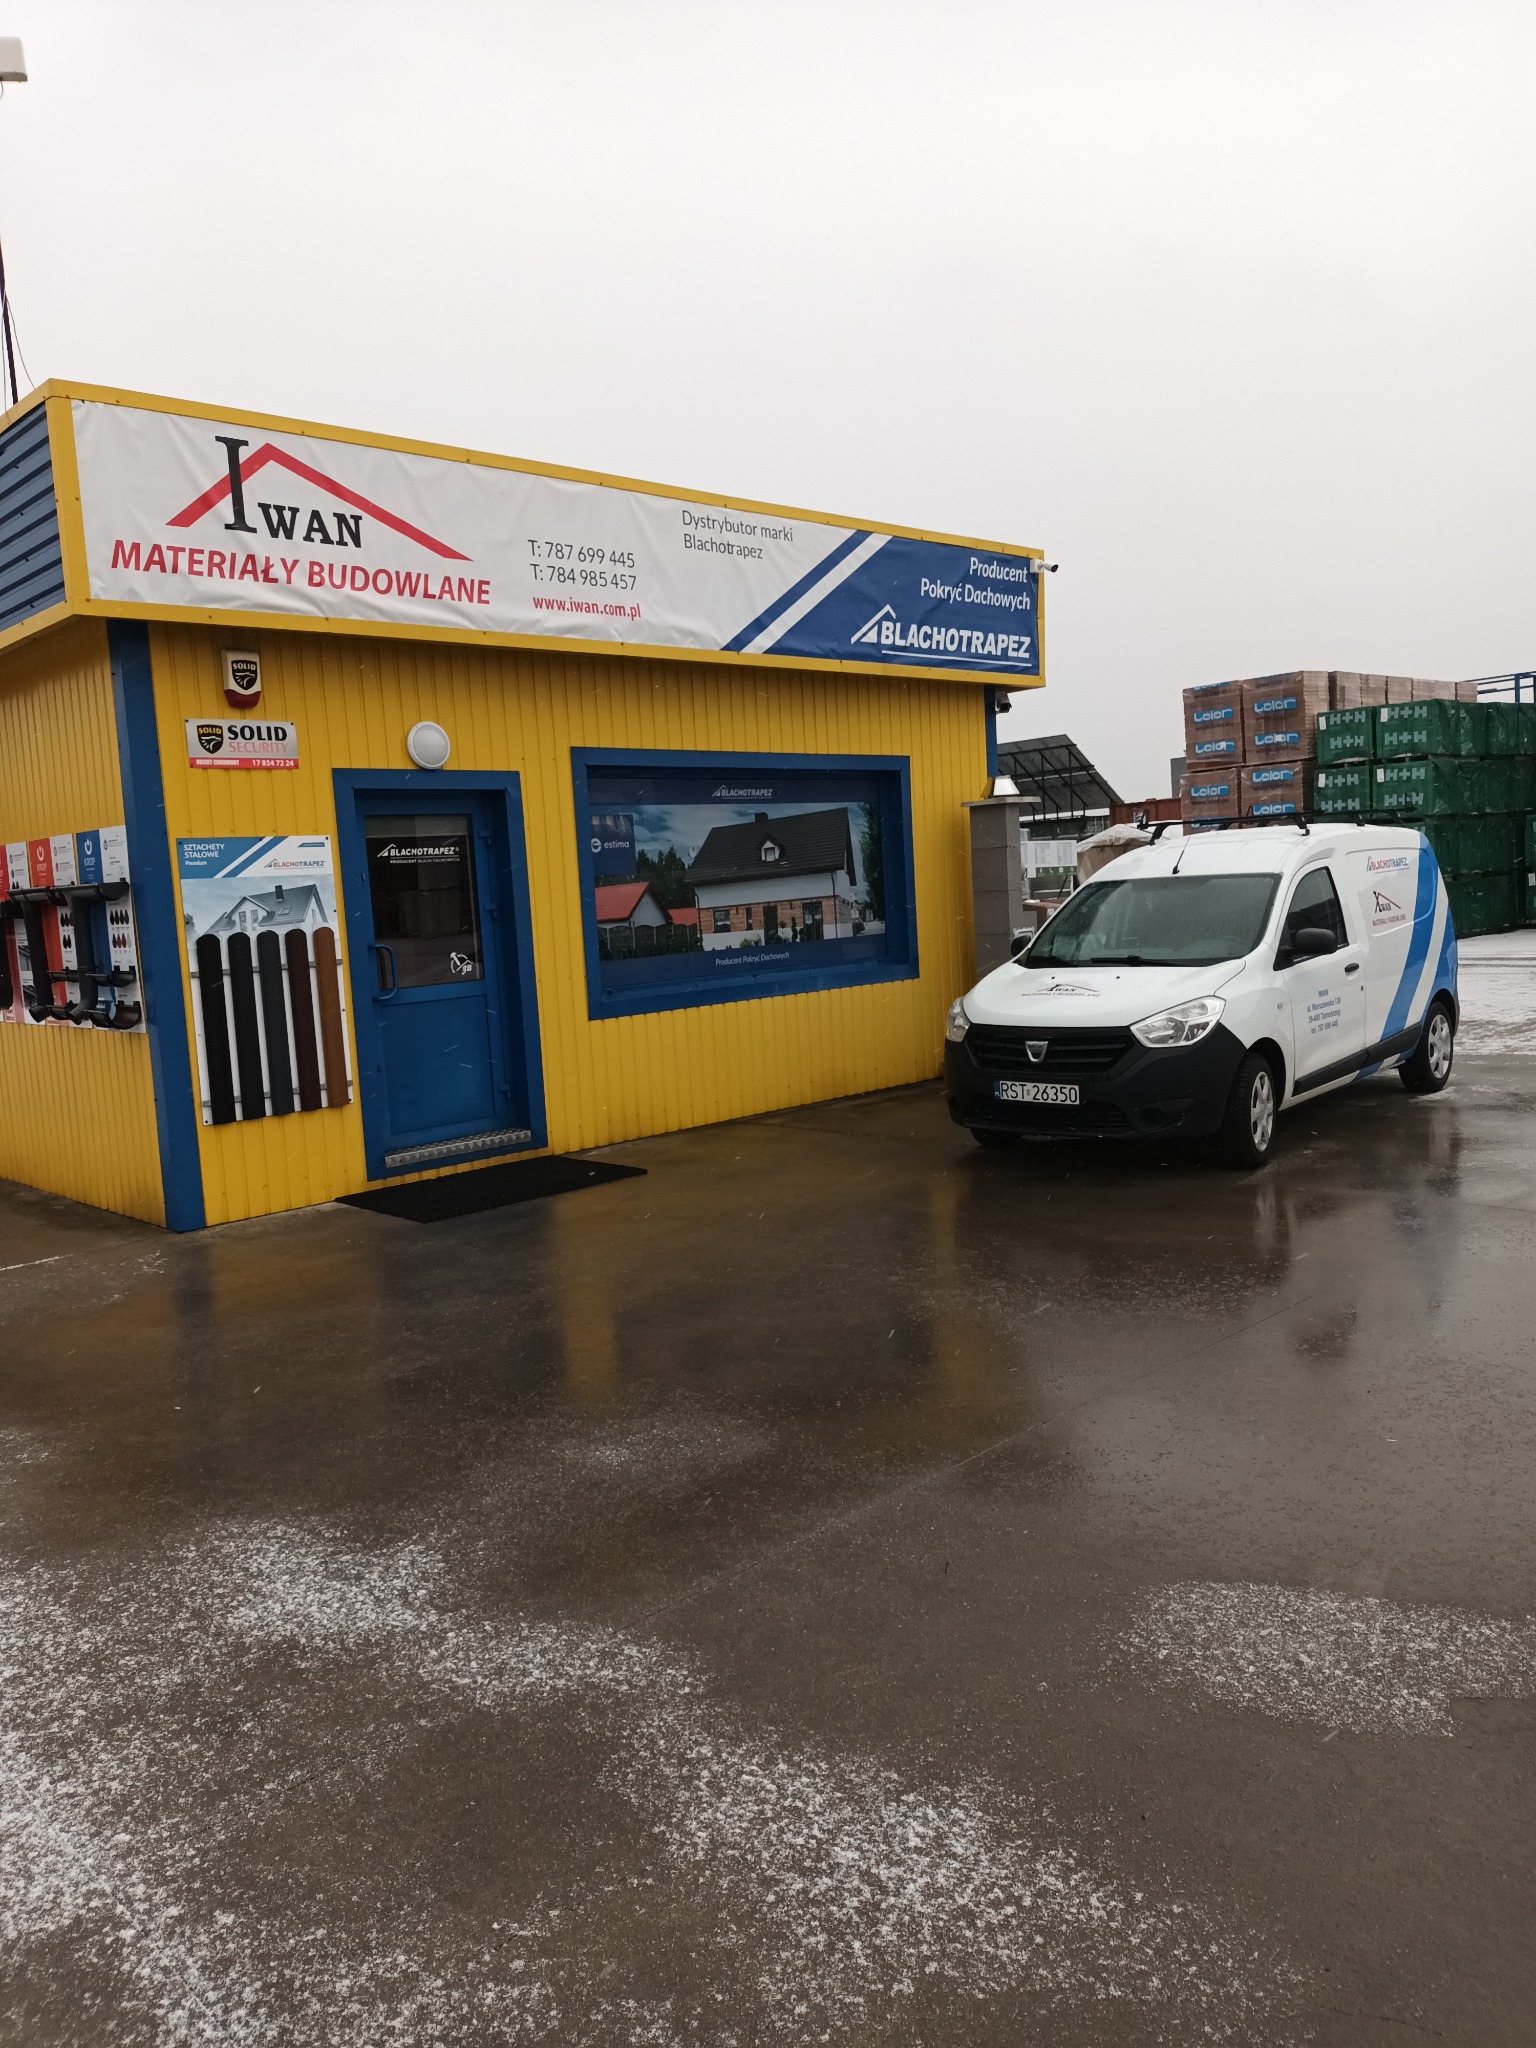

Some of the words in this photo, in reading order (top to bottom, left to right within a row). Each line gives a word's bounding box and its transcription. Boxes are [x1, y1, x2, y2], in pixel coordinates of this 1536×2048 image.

[215, 436, 363, 548] IWAN
[682, 510, 758, 537] Dystrybutor
[760, 524, 793, 543] marki
[528, 539, 542, 558] T:
[545, 541, 573, 560] 787
[578, 546, 605, 565] 699
[609, 550, 635, 568] 445
[683, 533, 763, 560] Blachotrapez
[111, 539, 299, 586] MATERIAŁY
[307, 560, 491, 604] BUDOWLANE
[530, 564, 543, 581] T:
[547, 566, 576, 584] 784
[579, 569, 608, 587] 985
[611, 573, 636, 590] 457
[969, 556, 1028, 583] Producent
[920, 578, 962, 604] Pokryć
[965, 584, 1030, 612] Dachowych
[532, 596, 641, 621] www.iwan.com.pl
[881, 620, 1031, 658] BLACHOTRAPEZ
[232, 662, 256, 671] SOLID
[1329, 710, 1366, 725] H+H
[1387, 705, 1427, 719] H+H
[198, 727, 222, 735] SOLID
[227, 725, 287, 741] SOLID
[1384, 730, 1427, 745] H+H
[228, 741, 288, 754] SECURITY
[1329, 735, 1365, 749] H+H
[252, 759, 261, 767] 17
[275, 759, 284, 767] 72
[285, 759, 294, 767] 24
[1385, 767, 1425, 781] H+H
[721, 788, 773, 797] BLACHOTRAPEZ
[390, 846, 455, 857] BLACHOTRAPEZ
[604, 840, 630, 848] estima
[272, 860, 325, 868] BLACHOTRAPEZ
[715, 957, 742, 967] Producent
[742, 953, 760, 964] Pokryć
[761, 951, 789, 962] Dachowych
[1001, 1082, 1026, 1100] RST
[1032, 1084, 1078, 1103] 26350
